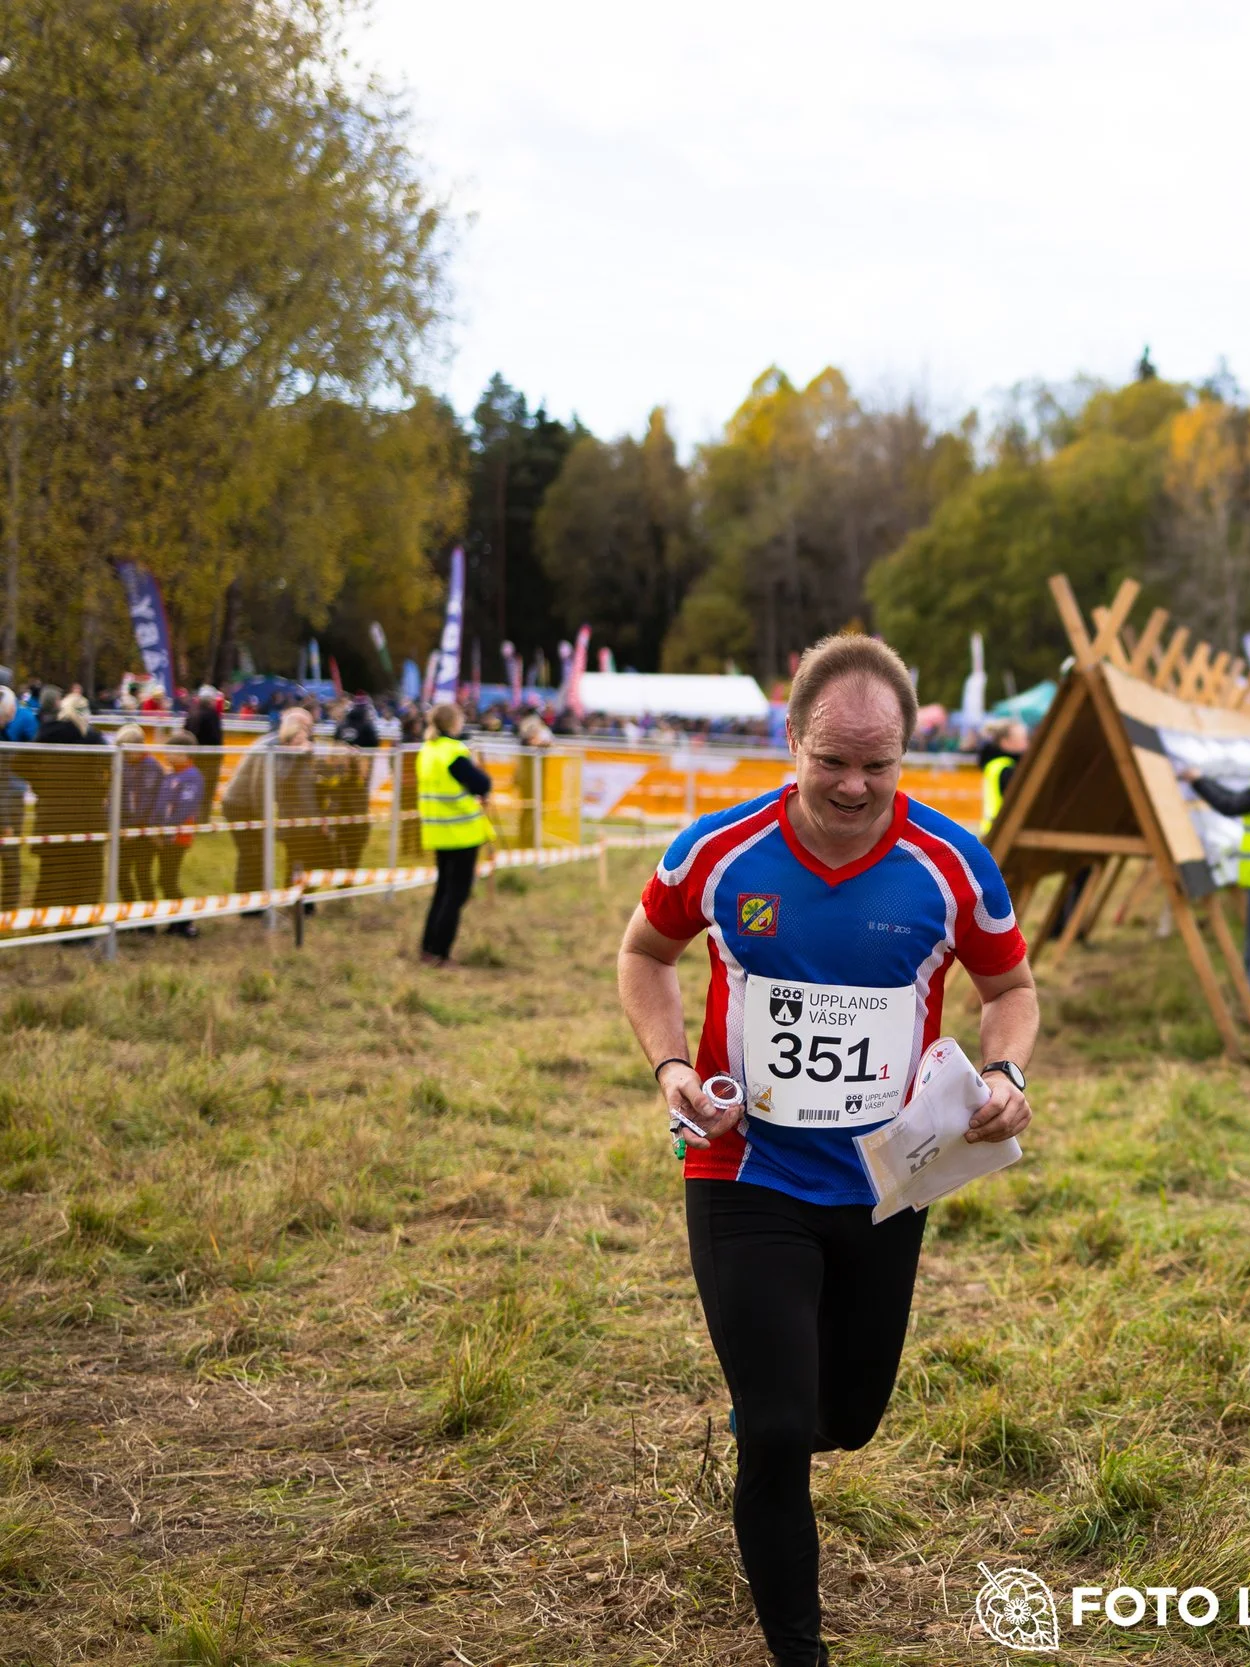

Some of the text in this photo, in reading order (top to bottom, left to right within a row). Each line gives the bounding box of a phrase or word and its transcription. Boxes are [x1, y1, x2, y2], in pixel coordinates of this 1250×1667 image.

[809, 993, 888, 1010] UPPLANDS
[809, 1009, 857, 1026] VÄSBY
[768, 1032, 877, 1083] 351
[878, 1063, 890, 1081] 1
[865, 1089, 900, 1102] UPPLANDS
[864, 1100, 886, 1111] VÄSBY
